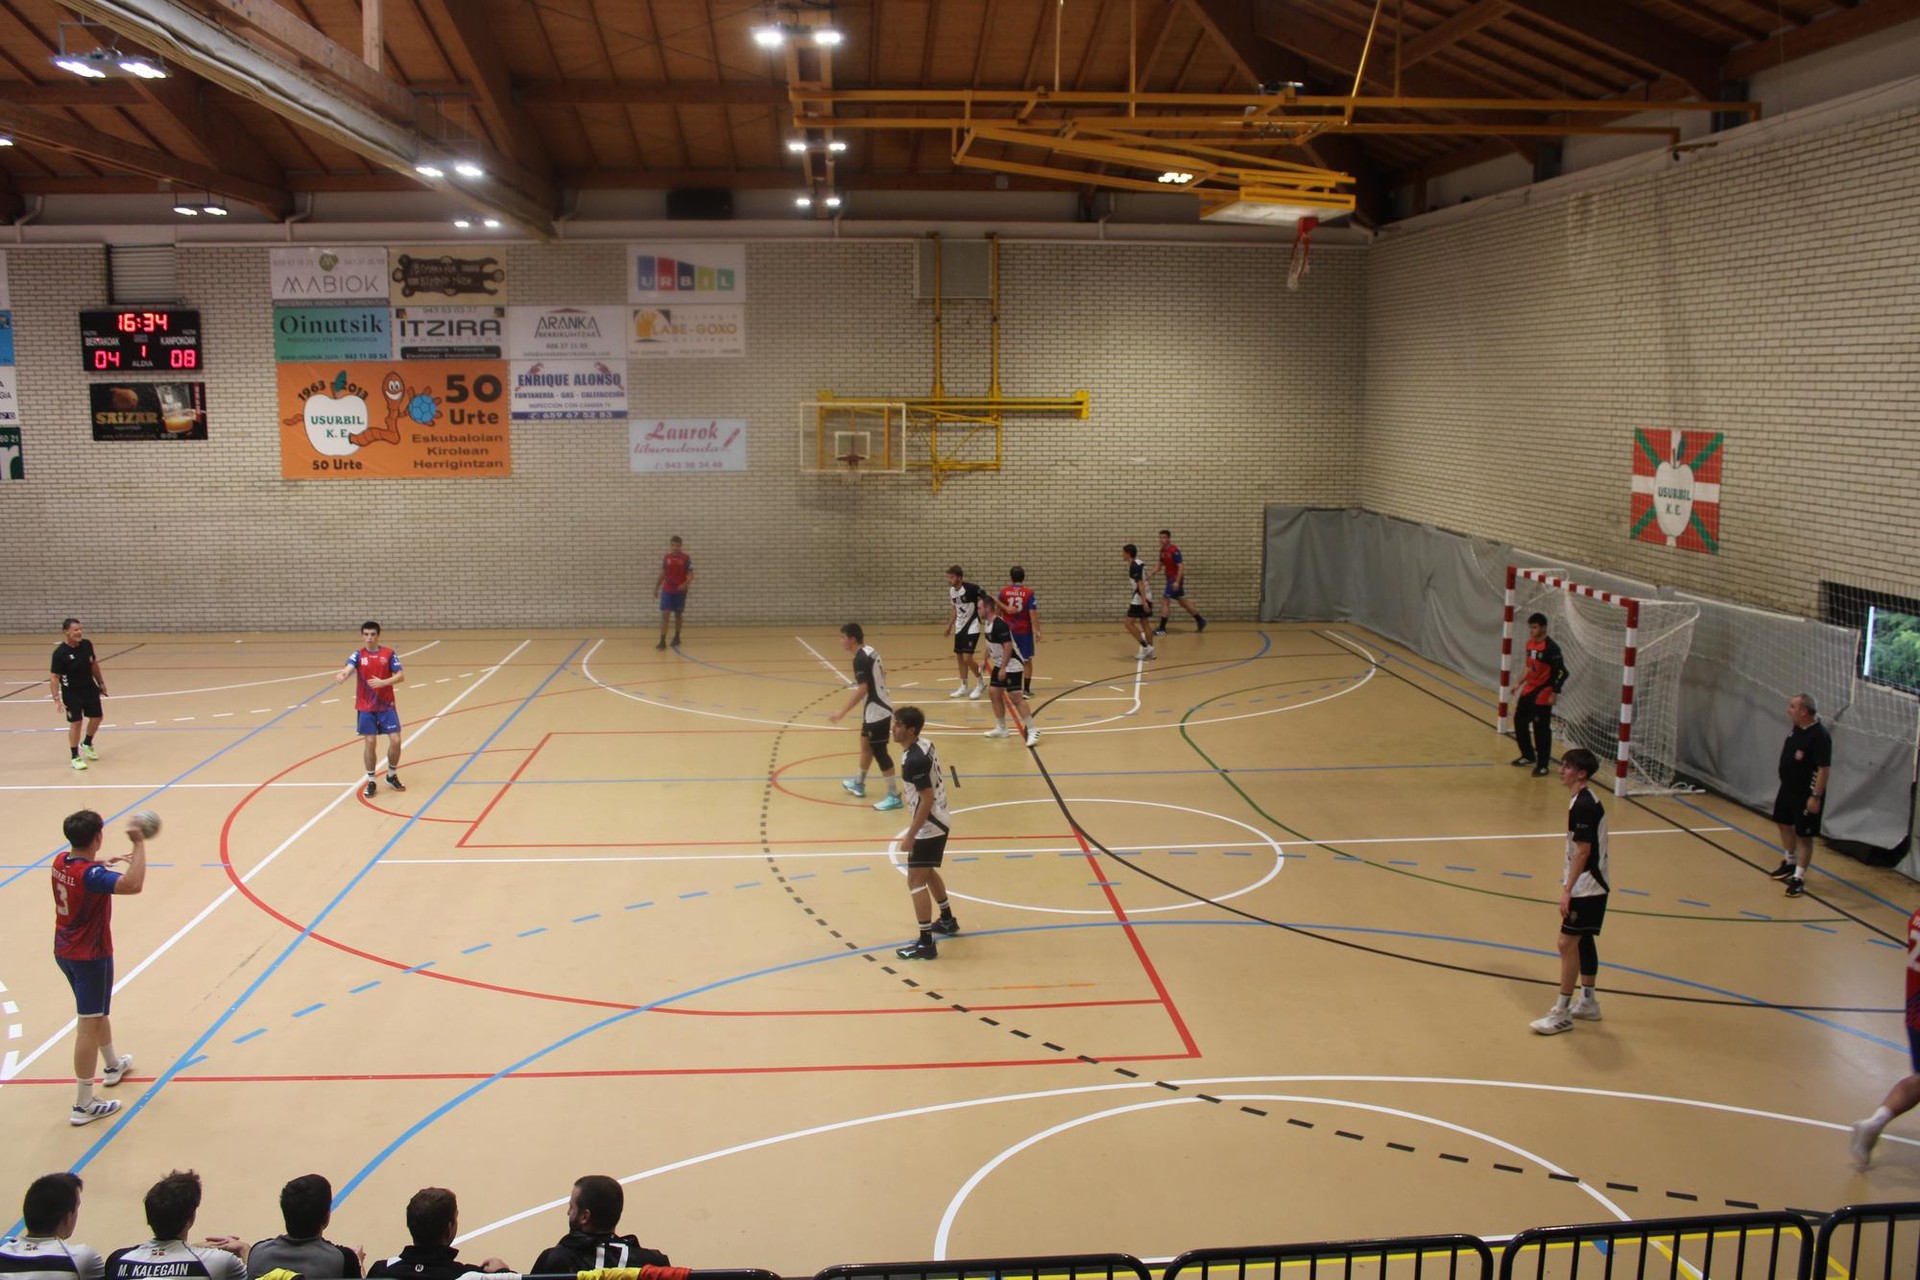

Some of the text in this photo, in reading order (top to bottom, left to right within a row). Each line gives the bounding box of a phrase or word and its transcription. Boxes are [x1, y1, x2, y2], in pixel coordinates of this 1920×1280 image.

[282, 275, 378, 293] MABIOK
[640, 275, 731, 288] URBIL
[117, 313, 168, 332] 16:34
[280, 314, 383, 334] Oinutsik
[400, 319, 501, 336] ITZIRA
[534, 316, 602, 338] ARANKA
[95, 350, 120, 369] 04
[141, 345, 147, 358] 1
[170, 349, 196, 368] 08
[518, 373, 621, 387] ENRIQUE ALONSO
[297, 380, 326, 401] 1963
[446, 374, 502, 403] 50
[310, 415, 365, 425] USURBIL
[449, 409, 499, 425] Urte
[412, 434, 503, 443] Eskubaloian
[645, 421, 718, 440] Laurok
[427, 446, 489, 457] Kirolean
[312, 459, 363, 470] 50 Urte
[413, 460, 503, 471] Herrigintzan
[1658, 486, 1691, 501] USURBIL
[56, 882, 69, 915] 3
[118, 1264, 189, 1277] M. KALEGAIN
